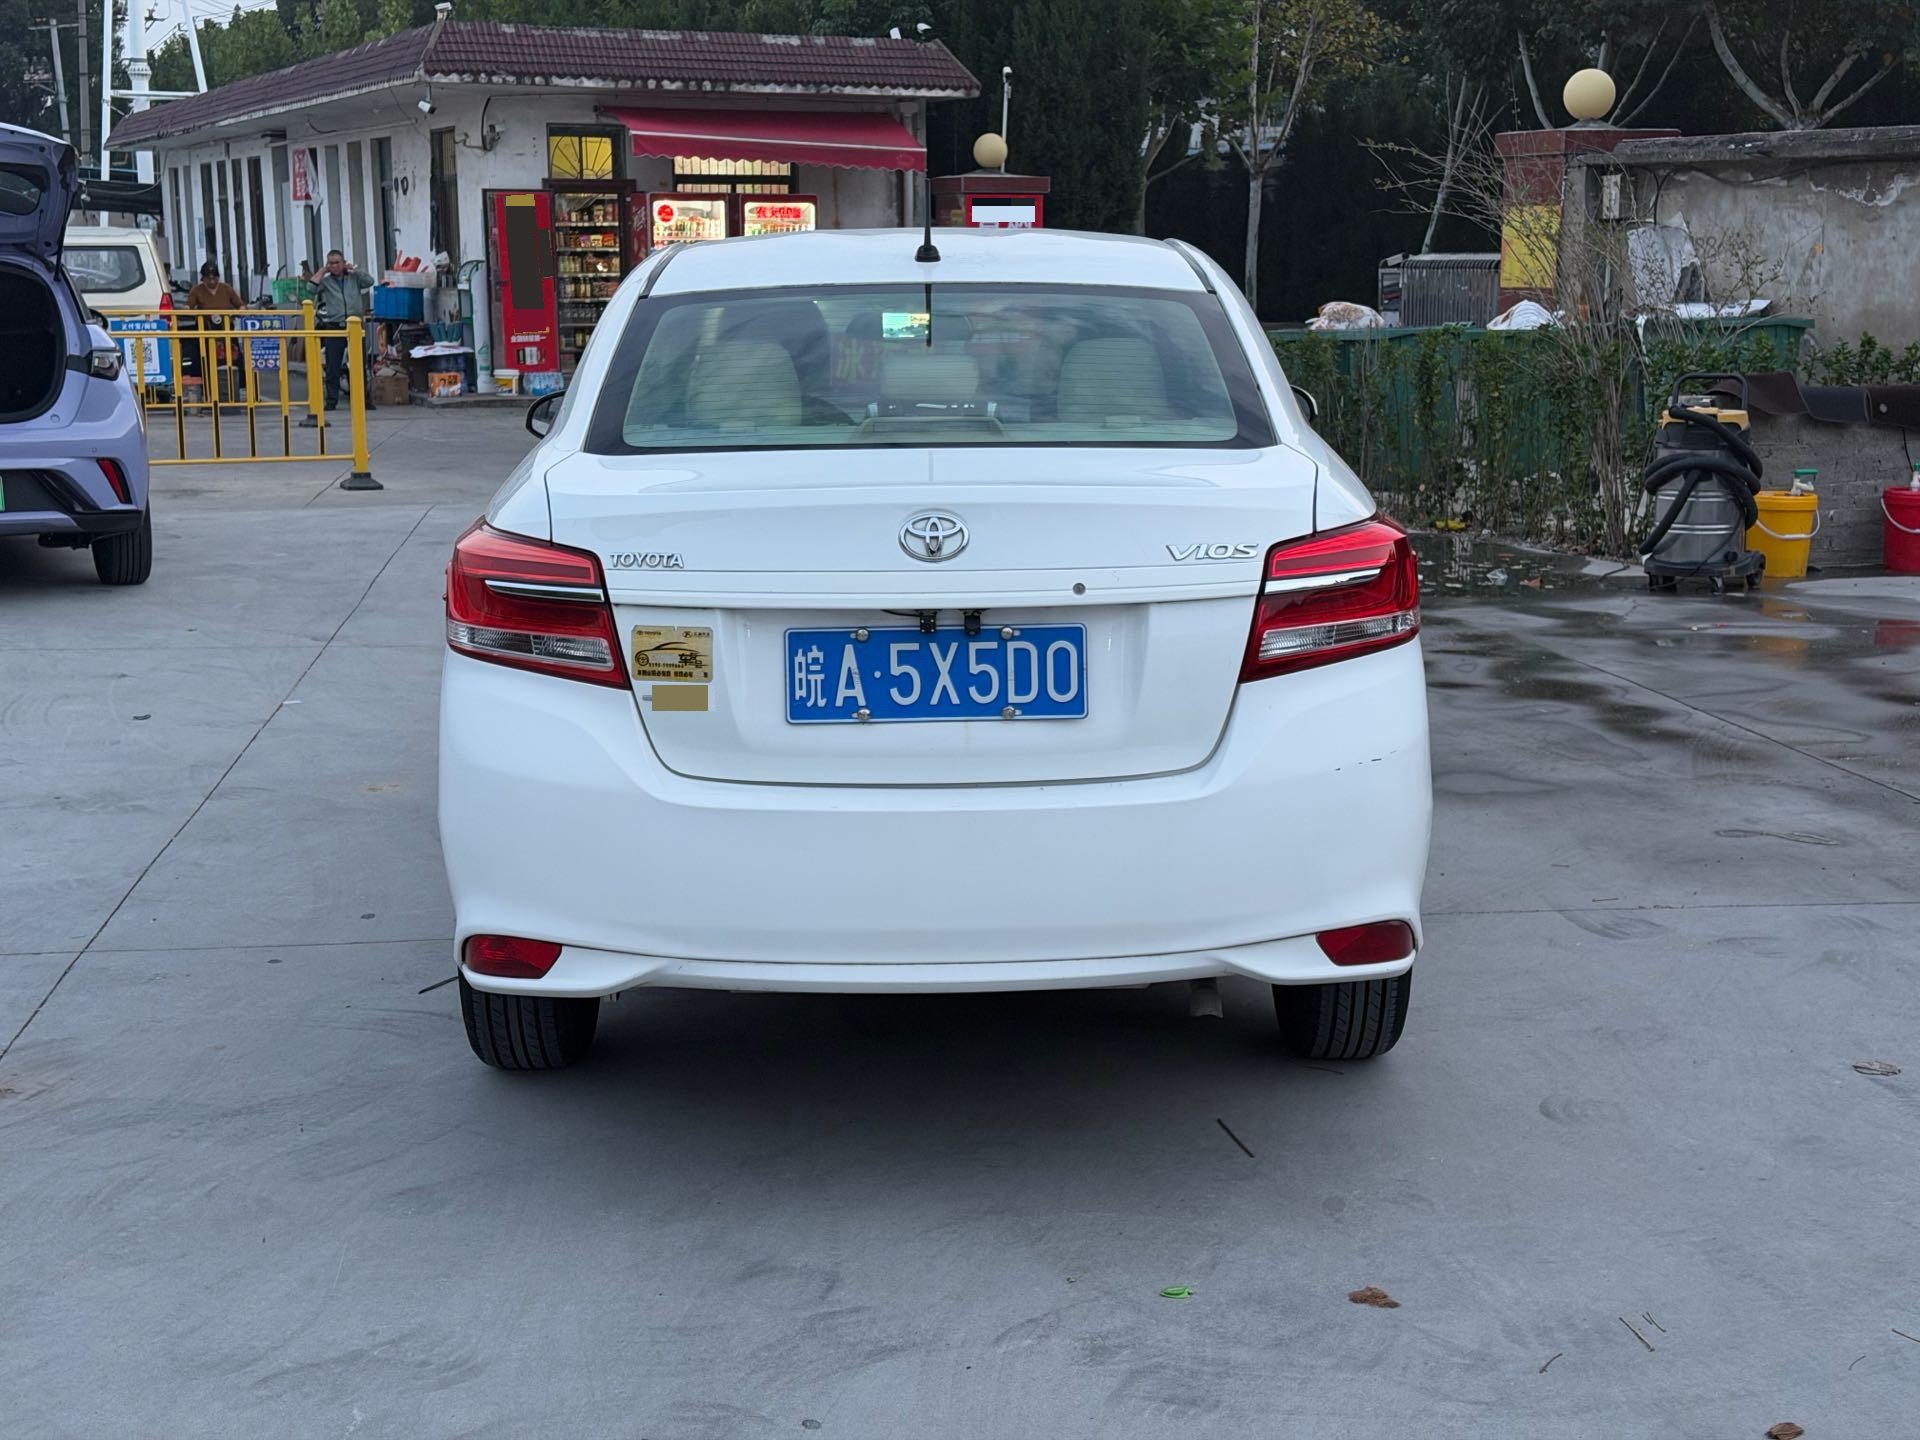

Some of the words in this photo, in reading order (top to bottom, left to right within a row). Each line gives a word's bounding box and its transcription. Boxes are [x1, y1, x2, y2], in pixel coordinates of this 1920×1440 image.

[245, 319, 260, 331] P
[610, 552, 684, 569] TOYOTA
[1165, 543, 1259, 561] VIOS
